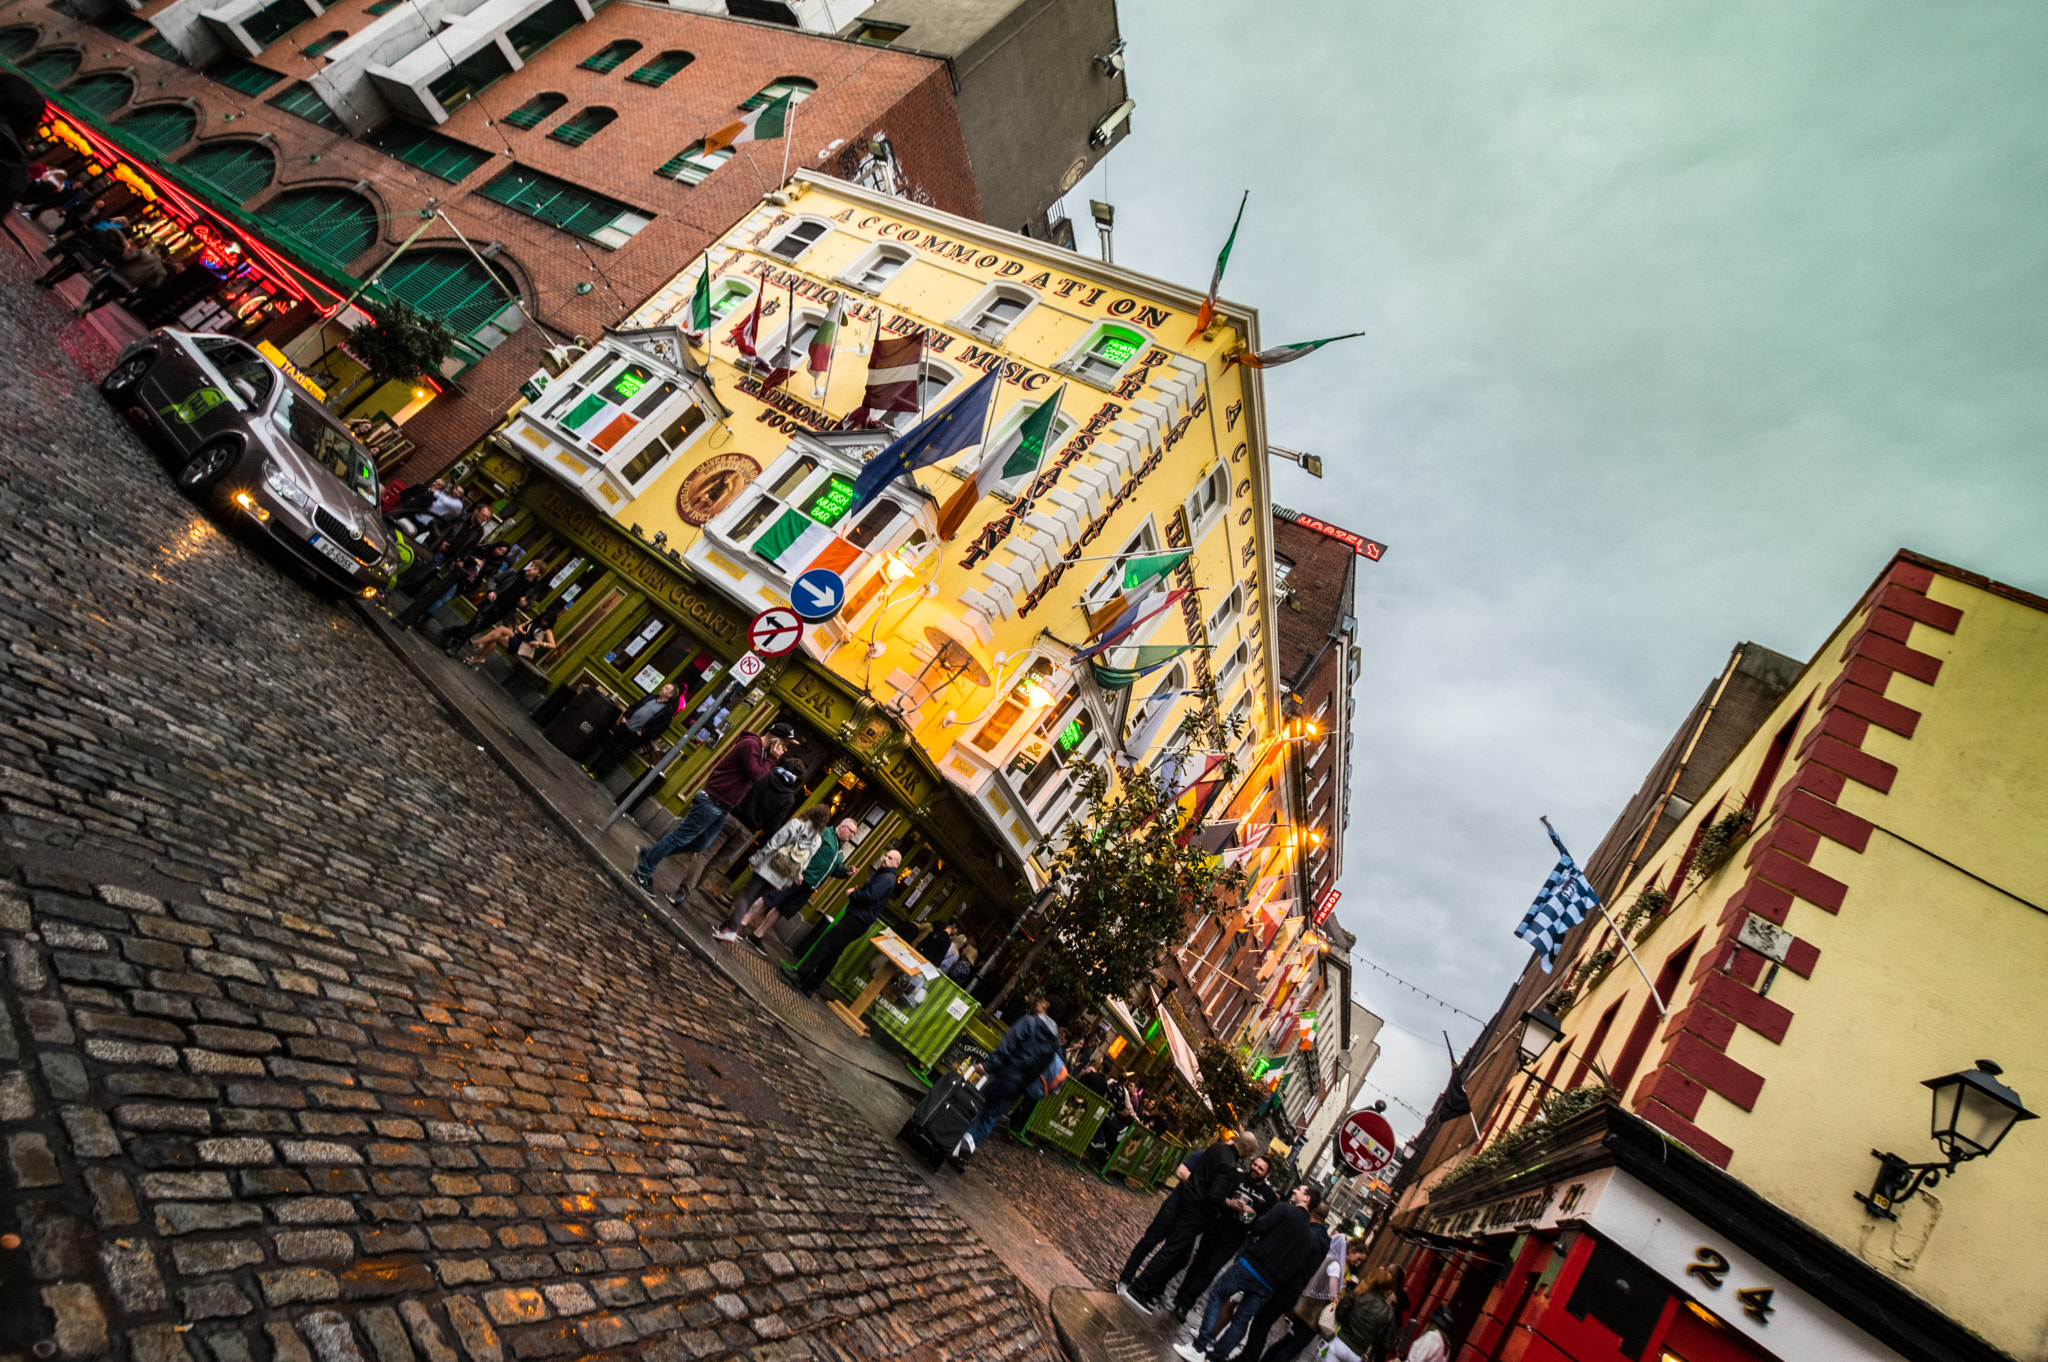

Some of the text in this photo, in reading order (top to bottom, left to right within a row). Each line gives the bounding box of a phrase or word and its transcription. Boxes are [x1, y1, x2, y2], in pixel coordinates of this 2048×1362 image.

[829, 207, 1174, 330] ACCOMMODATION
[281, 361, 306, 385] TAXI
[955, 345, 1050, 391] MUSIC
[958, 350, 1168, 570] BAR RESTAURANT
[811, 506, 831, 524] BAR
[816, 496, 844, 517] MUSIC
[1018, 393, 1206, 619] BAR RESTAURANT
[1298, 515, 1364, 554] HOSTEL
[669, 582, 748, 645] GOGARTY
[1316, 891, 1340, 924] HOSTEL
[879, 996, 910, 1025] APARTMENTS
[1874, 1195, 1889, 1209] 10
[1686, 1246, 1774, 1324] 24
